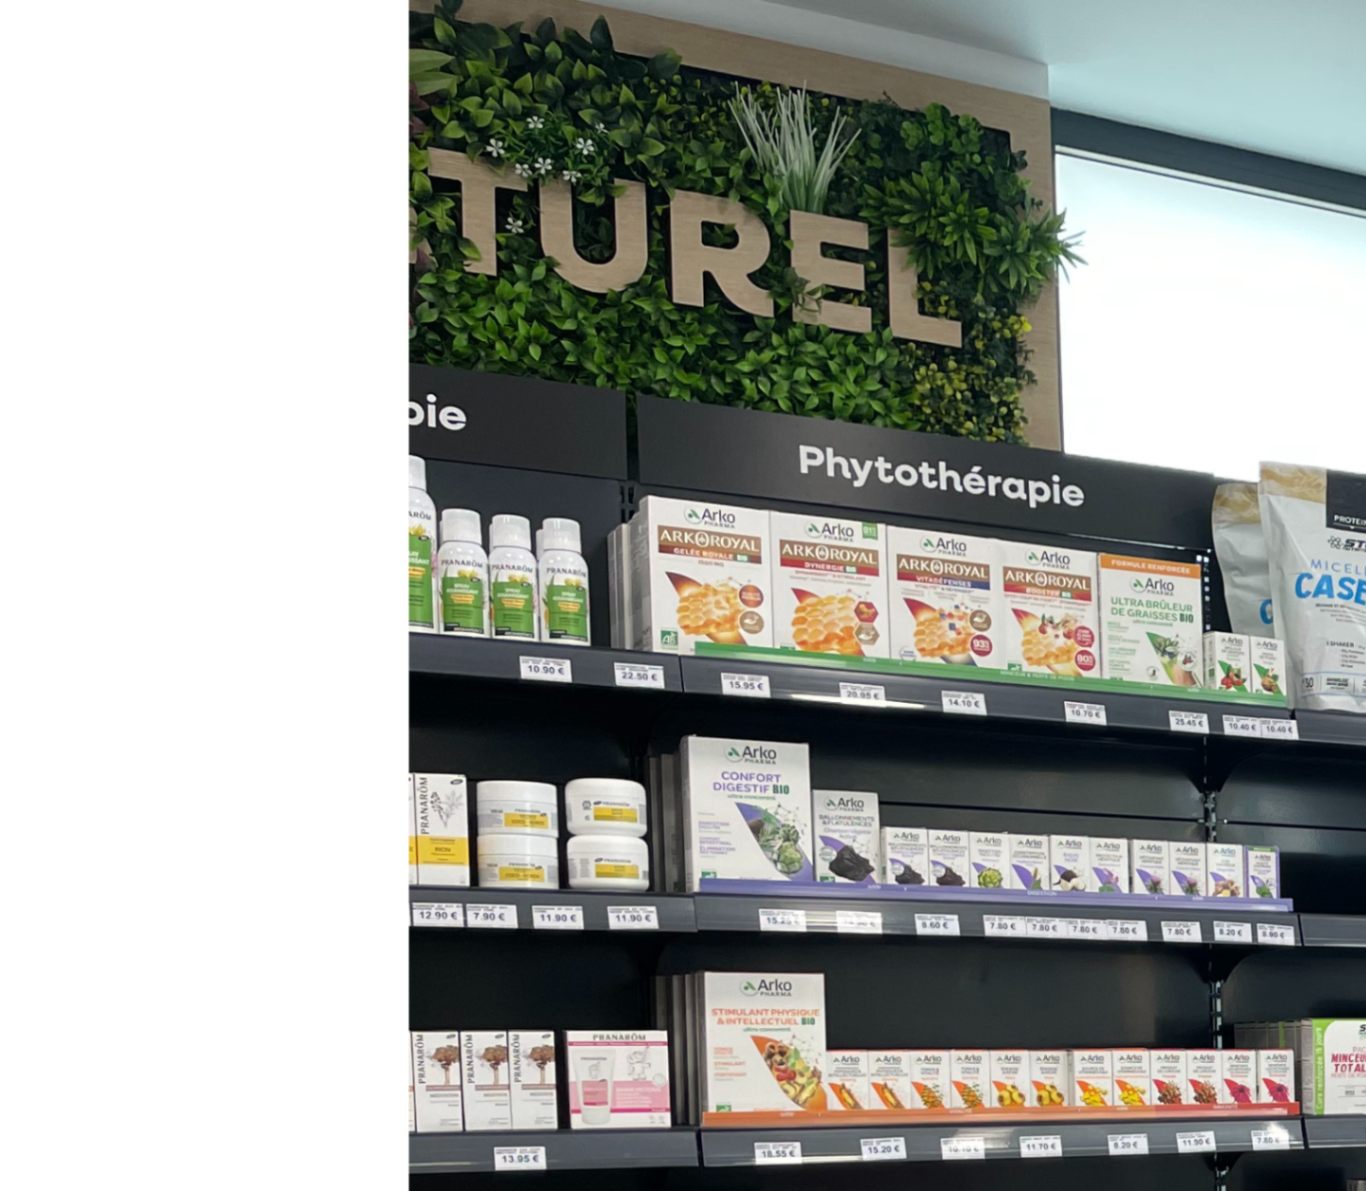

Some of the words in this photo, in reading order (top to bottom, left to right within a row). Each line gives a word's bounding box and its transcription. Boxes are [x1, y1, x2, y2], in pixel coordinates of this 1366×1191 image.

[409, 147, 962, 348] TUREL
[799, 445, 1085, 508] Phytothérapie
[702, 508, 735, 524] Arko
[821, 524, 854, 538] Arko
[936, 538, 967, 551] Arko
[1040, 551, 1070, 565] Arko
[1145, 578, 1174, 592] Arko
[1111, 597, 1144, 608] ULTRA
[1111, 608, 1125, 616] DE
[1127, 609, 1177, 622] GRAISSES
[1180, 612, 1194, 623] BIO
[528, 665, 556, 675] 10.90
[622, 671, 649, 681] 22.50
[730, 681, 755, 690] 15.95
[742, 746, 776, 759] Arko
[721, 771, 781, 783] CONFORT
[713, 782, 770, 794] DIGESTIF
[773, 784, 790, 794] BIO
[420, 911, 449, 920] 12.90
[474, 912, 495, 921] 7.90
[758, 979, 791, 992] Arko
[502, 1155, 530, 1163] 13.95
